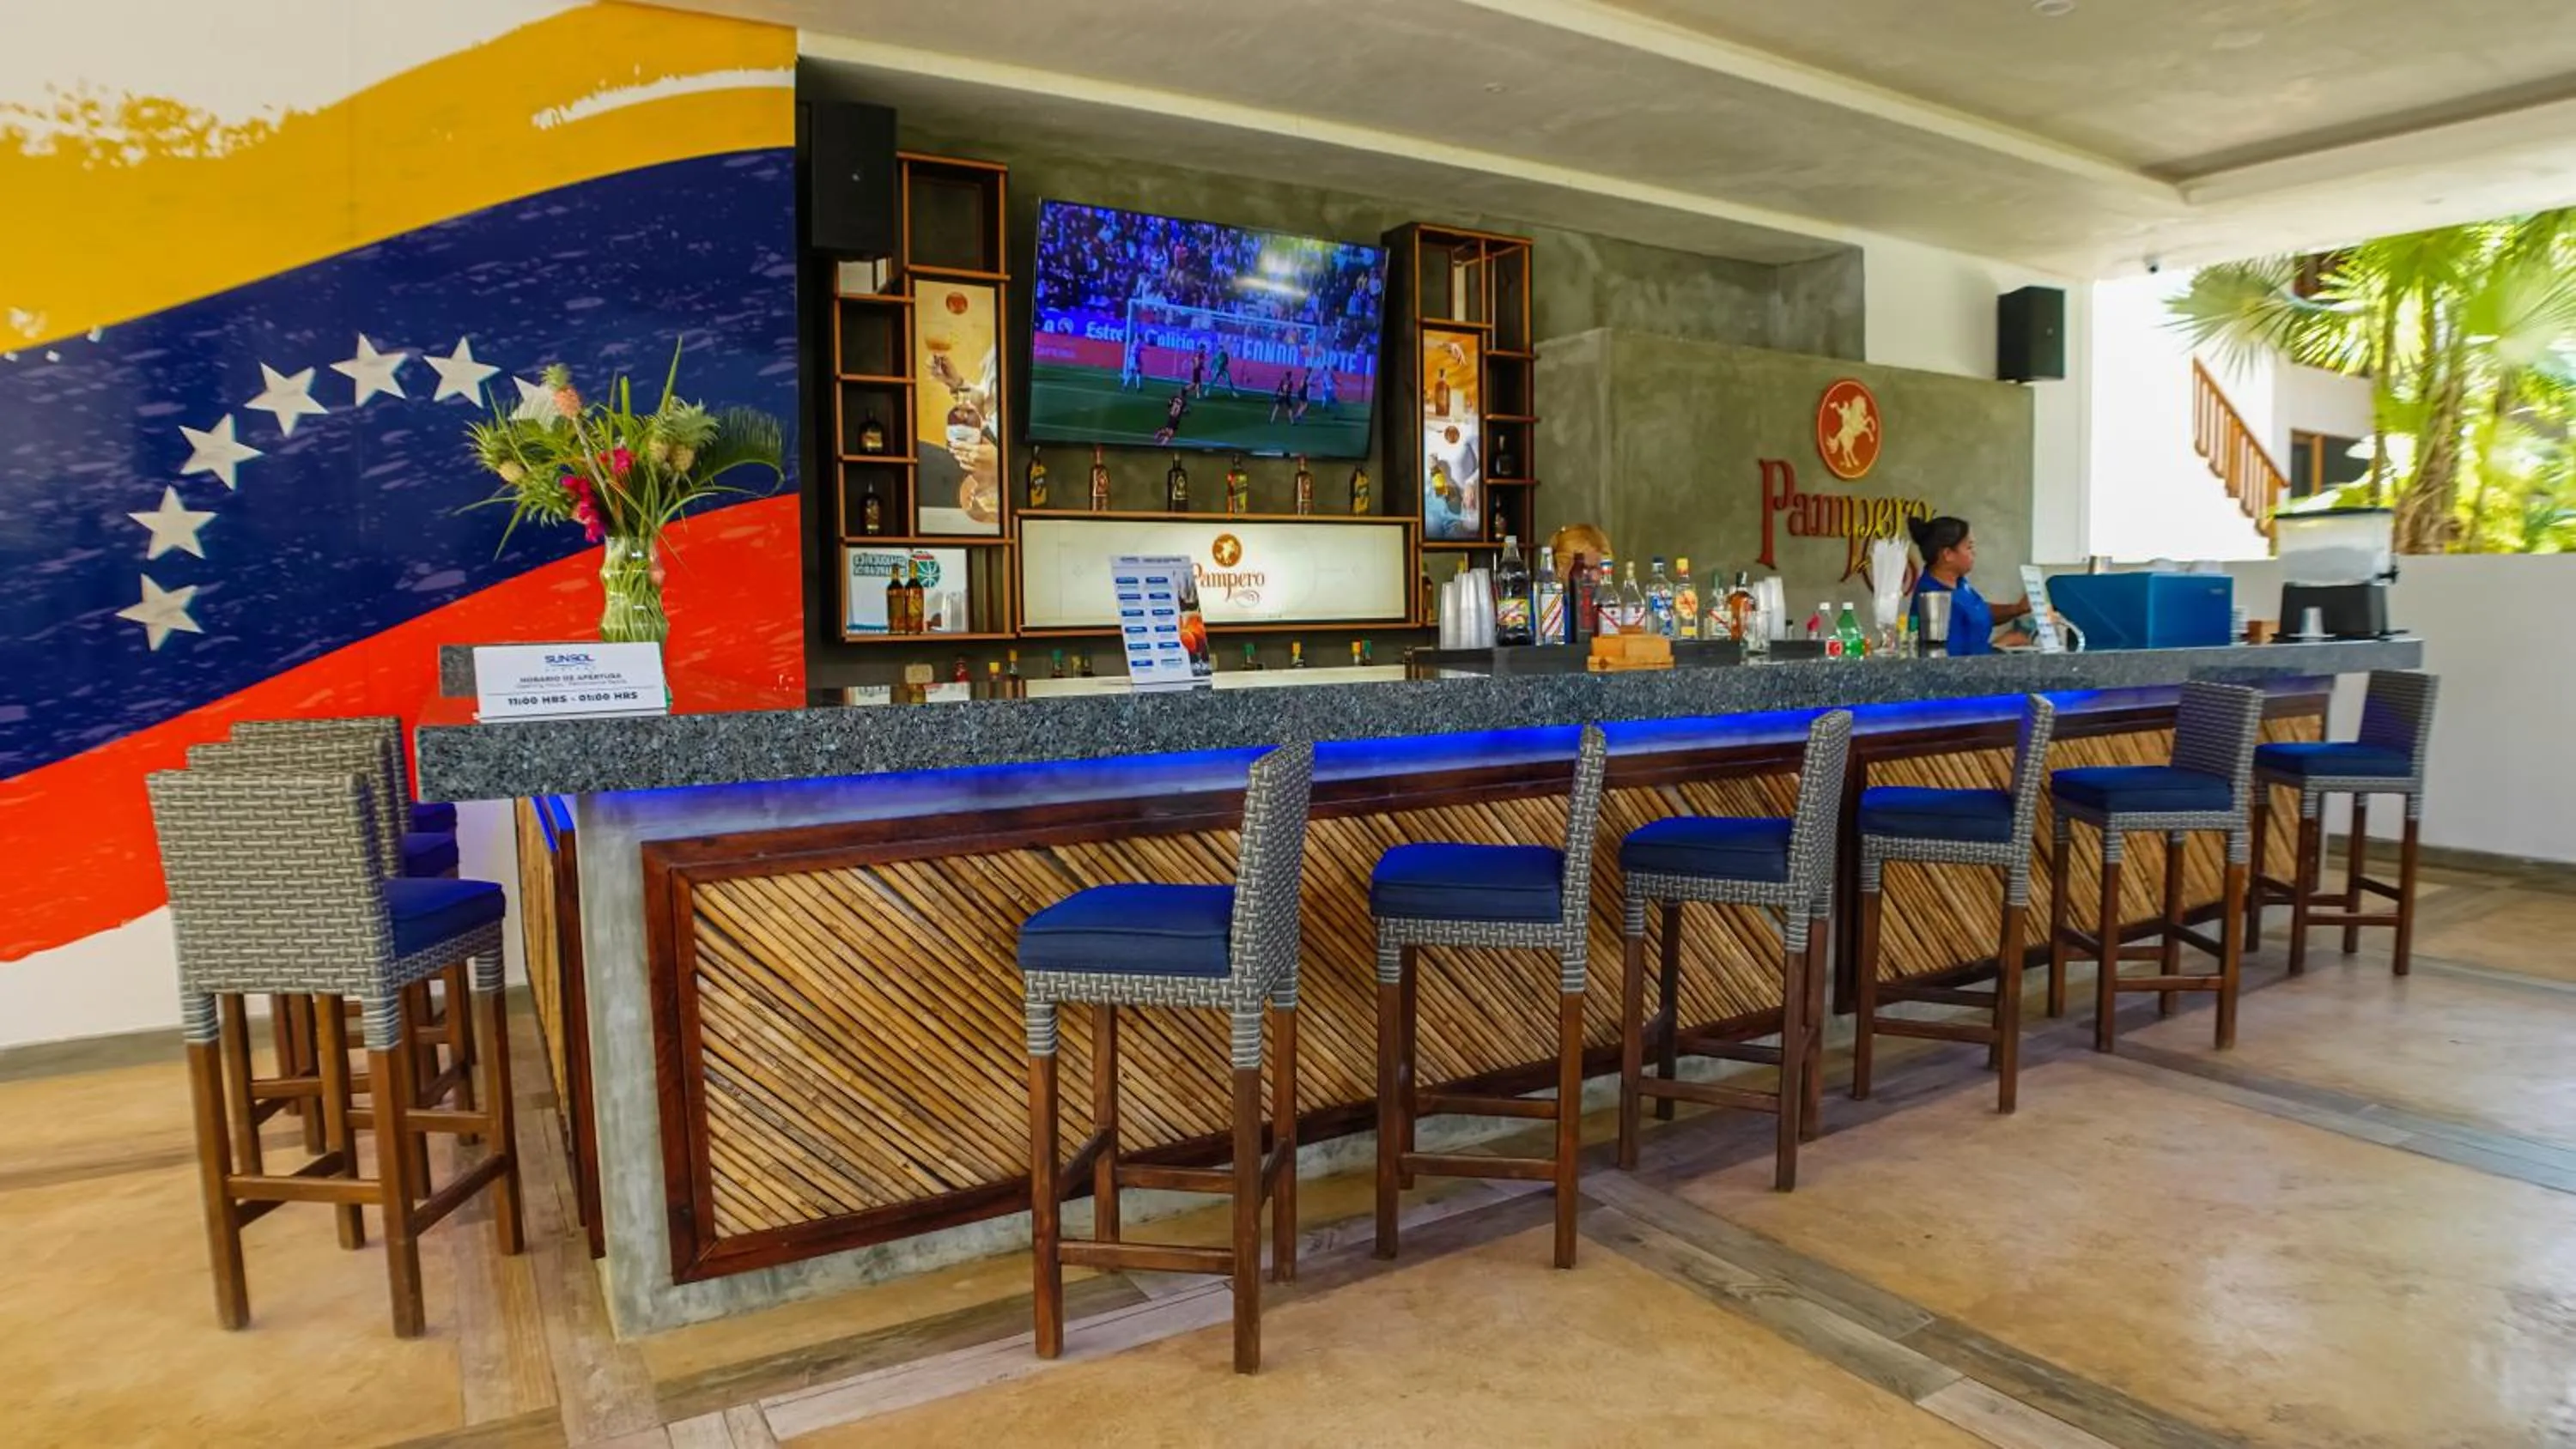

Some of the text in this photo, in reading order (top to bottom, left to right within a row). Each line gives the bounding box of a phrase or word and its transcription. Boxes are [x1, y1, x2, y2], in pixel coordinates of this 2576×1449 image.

[545, 654, 594, 664] SUNSOL
[508, 696, 538, 706] 11:00
[542, 694, 568, 705] HRS
[578, 693, 610, 701] 01:00
[614, 691, 638, 700] HRS
